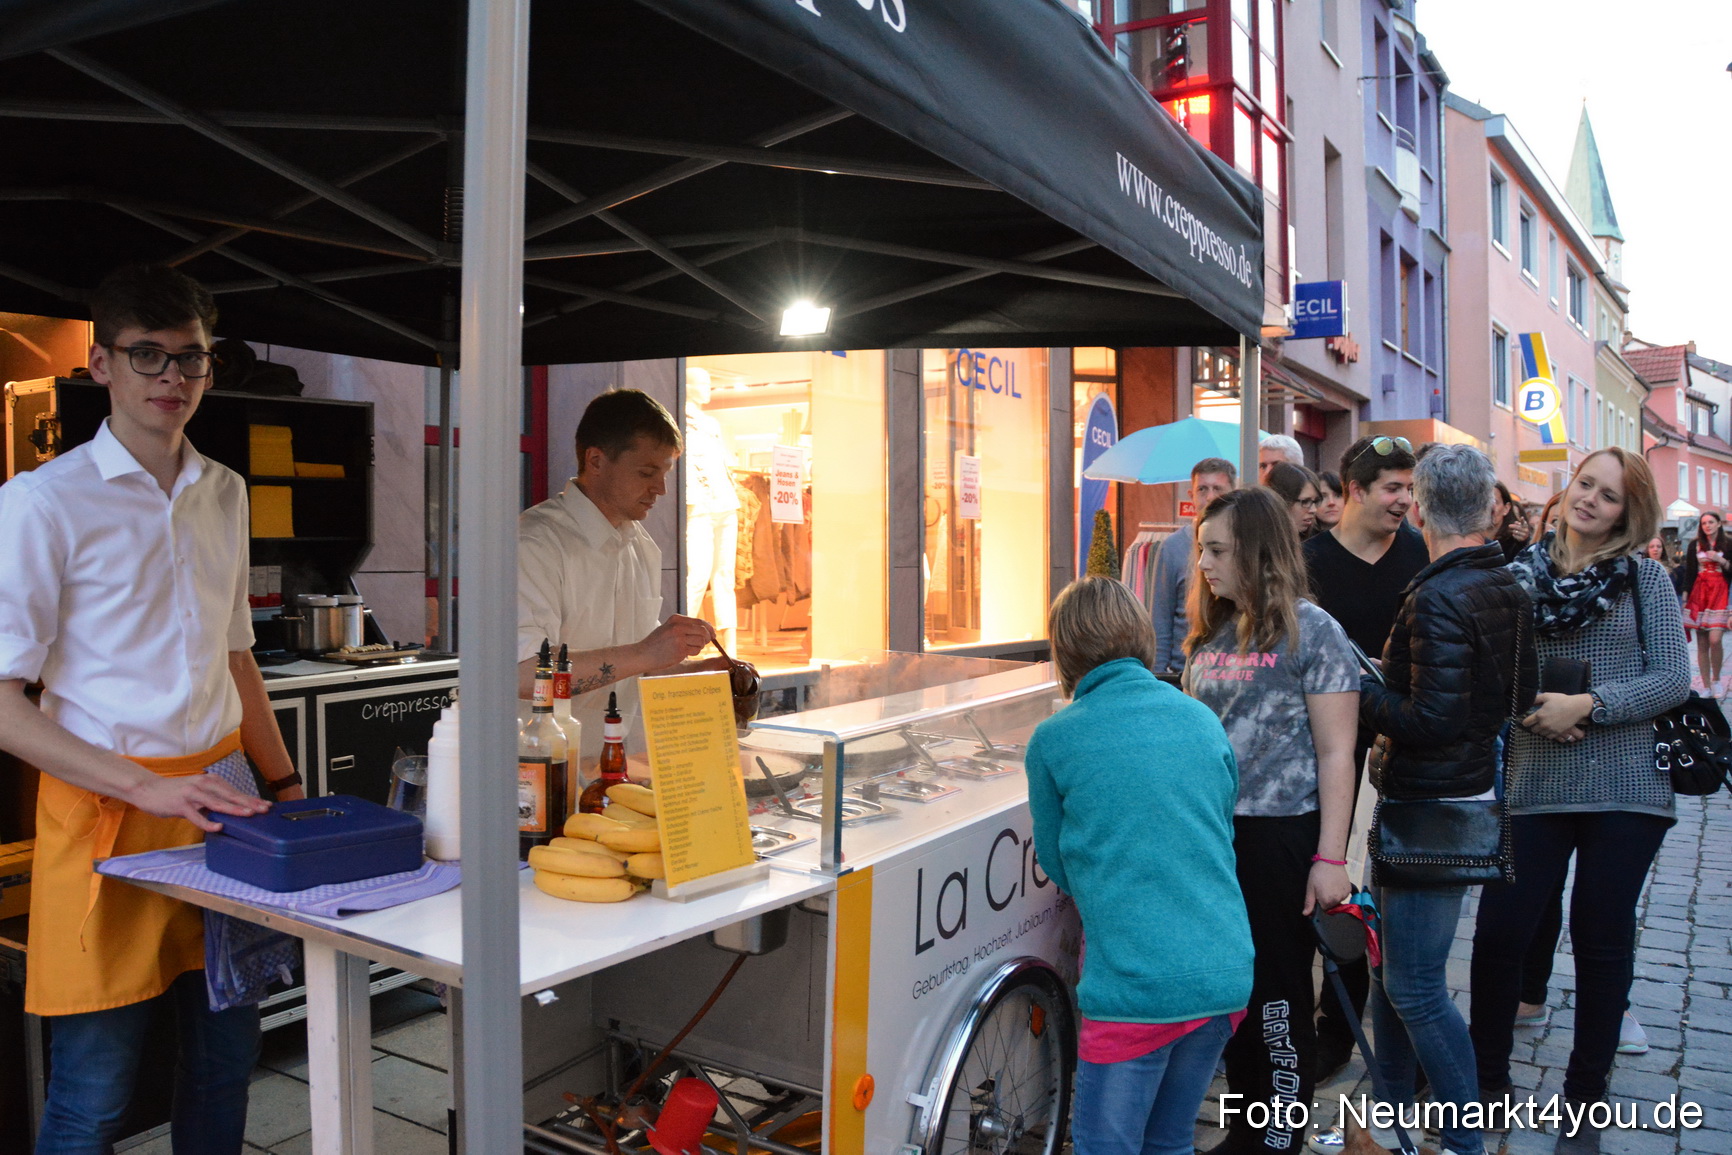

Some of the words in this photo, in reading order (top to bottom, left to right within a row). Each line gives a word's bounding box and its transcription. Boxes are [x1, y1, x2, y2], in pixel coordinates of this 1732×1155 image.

[1116, 152, 1252, 288] www.creppresso.de
[1296, 298, 1337, 316] ECIL
[957, 348, 1022, 399] CECIL
[1525, 390, 1544, 411] B
[1092, 426, 1113, 448] CECIL
[776, 470, 793, 478] Jeans
[777, 479, 796, 487] Hosen
[774, 491, 798, 505] -20%
[1202, 669, 1254, 681] LEAGUE
[915, 867, 968, 956] La
[912, 956, 970, 1000] Geburtstag,
[974, 928, 1012, 963] Hochzeit,
[1016, 908, 1052, 938] Jubiläum,
